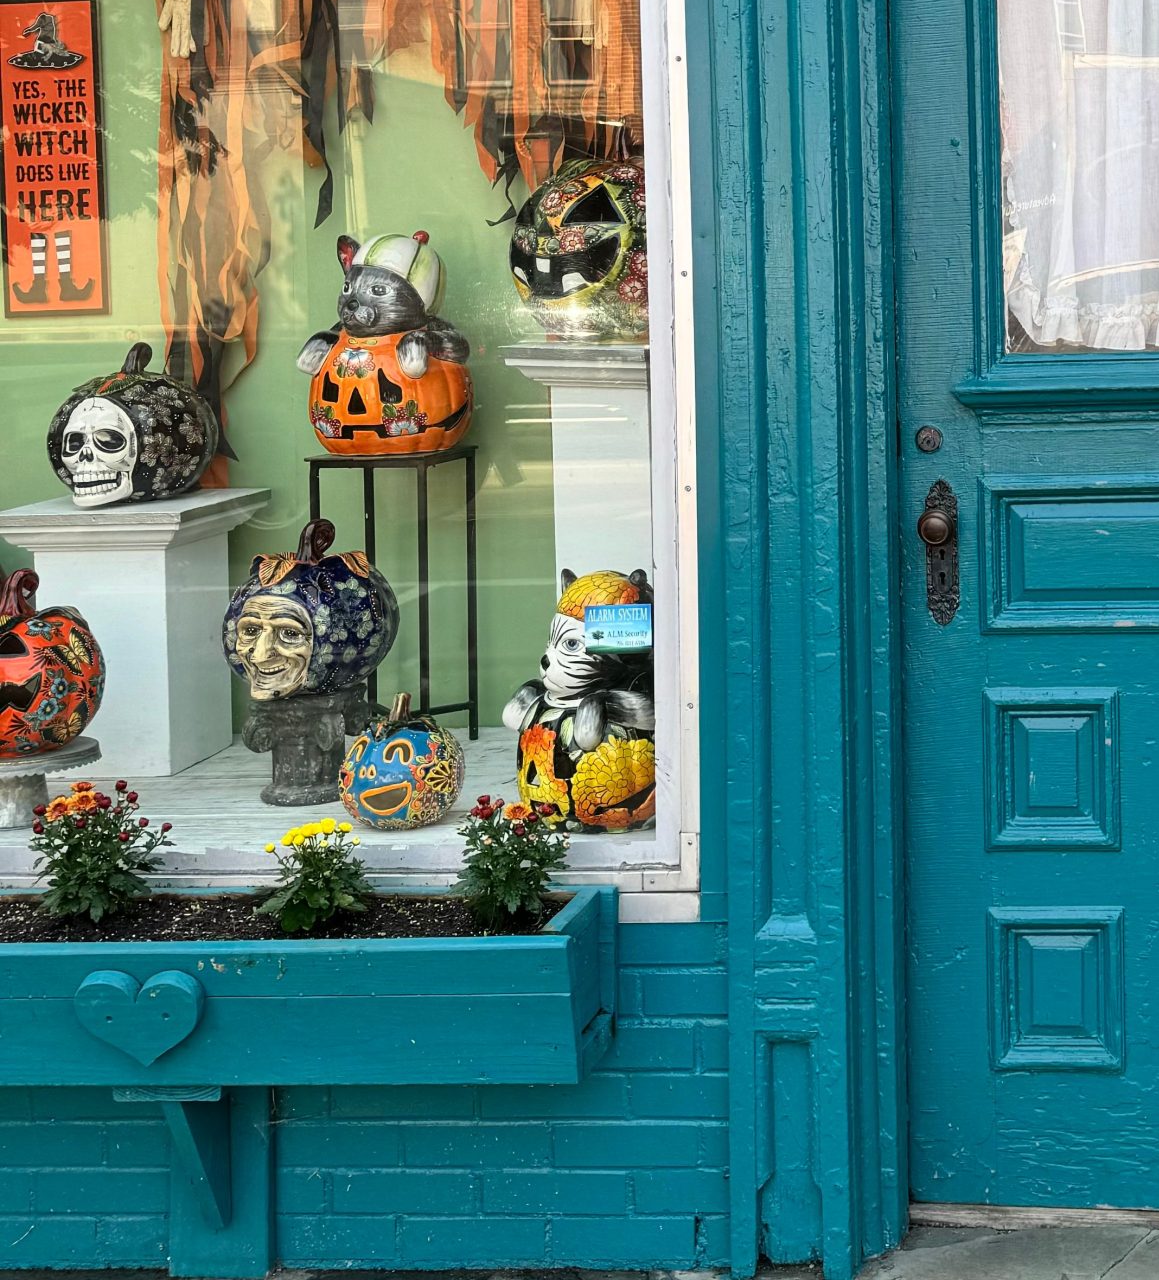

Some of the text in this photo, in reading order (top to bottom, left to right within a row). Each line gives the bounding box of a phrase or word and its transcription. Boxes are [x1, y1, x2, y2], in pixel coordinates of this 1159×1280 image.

[12, 78, 87, 100] YES, THE
[12, 101, 87, 125] WICKED
[13, 129, 88, 156] WITCH
[16, 162, 90, 183] DOES LIVE
[17, 188, 92, 222] HERE
[588, 607, 648, 622] ALARM SYSTEM
